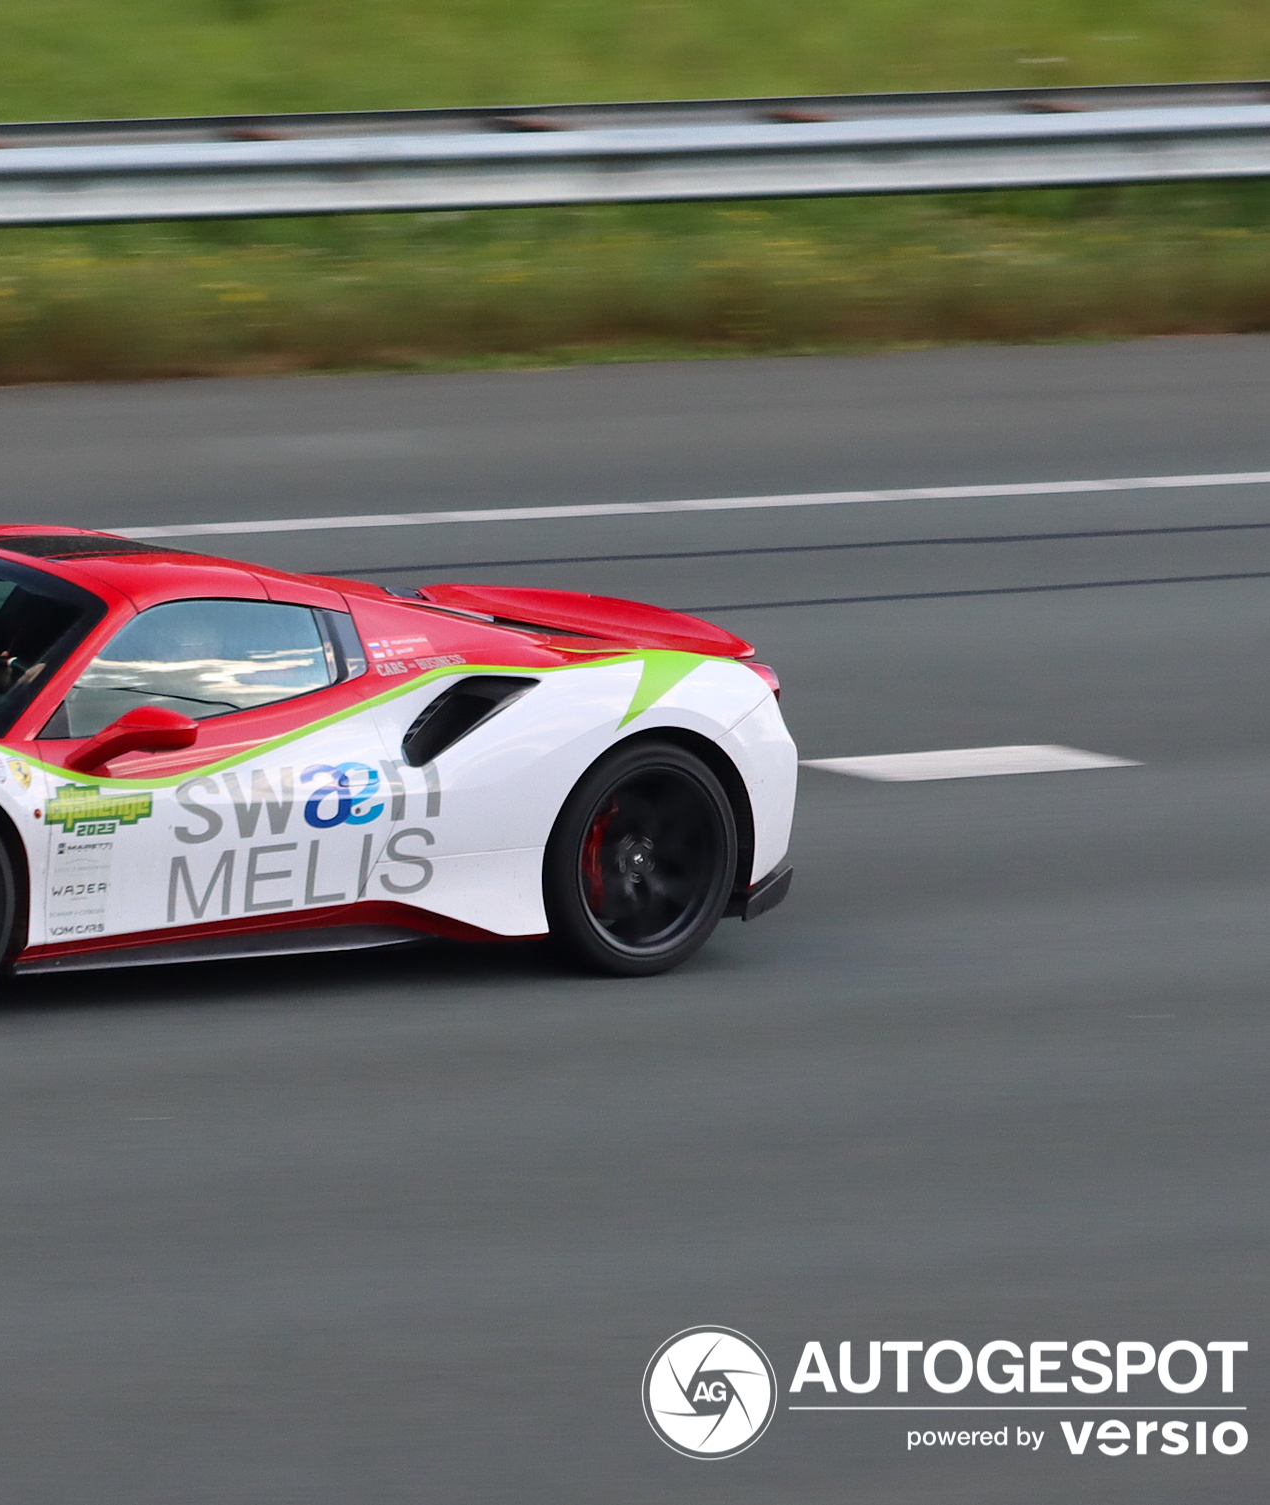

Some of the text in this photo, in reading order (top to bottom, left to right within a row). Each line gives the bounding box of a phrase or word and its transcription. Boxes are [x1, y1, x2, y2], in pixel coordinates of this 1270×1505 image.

[376, 654, 467, 677] CARS BUSINESS
[76, 822, 117, 837] 2023
[166, 827, 436, 923] MELIS
